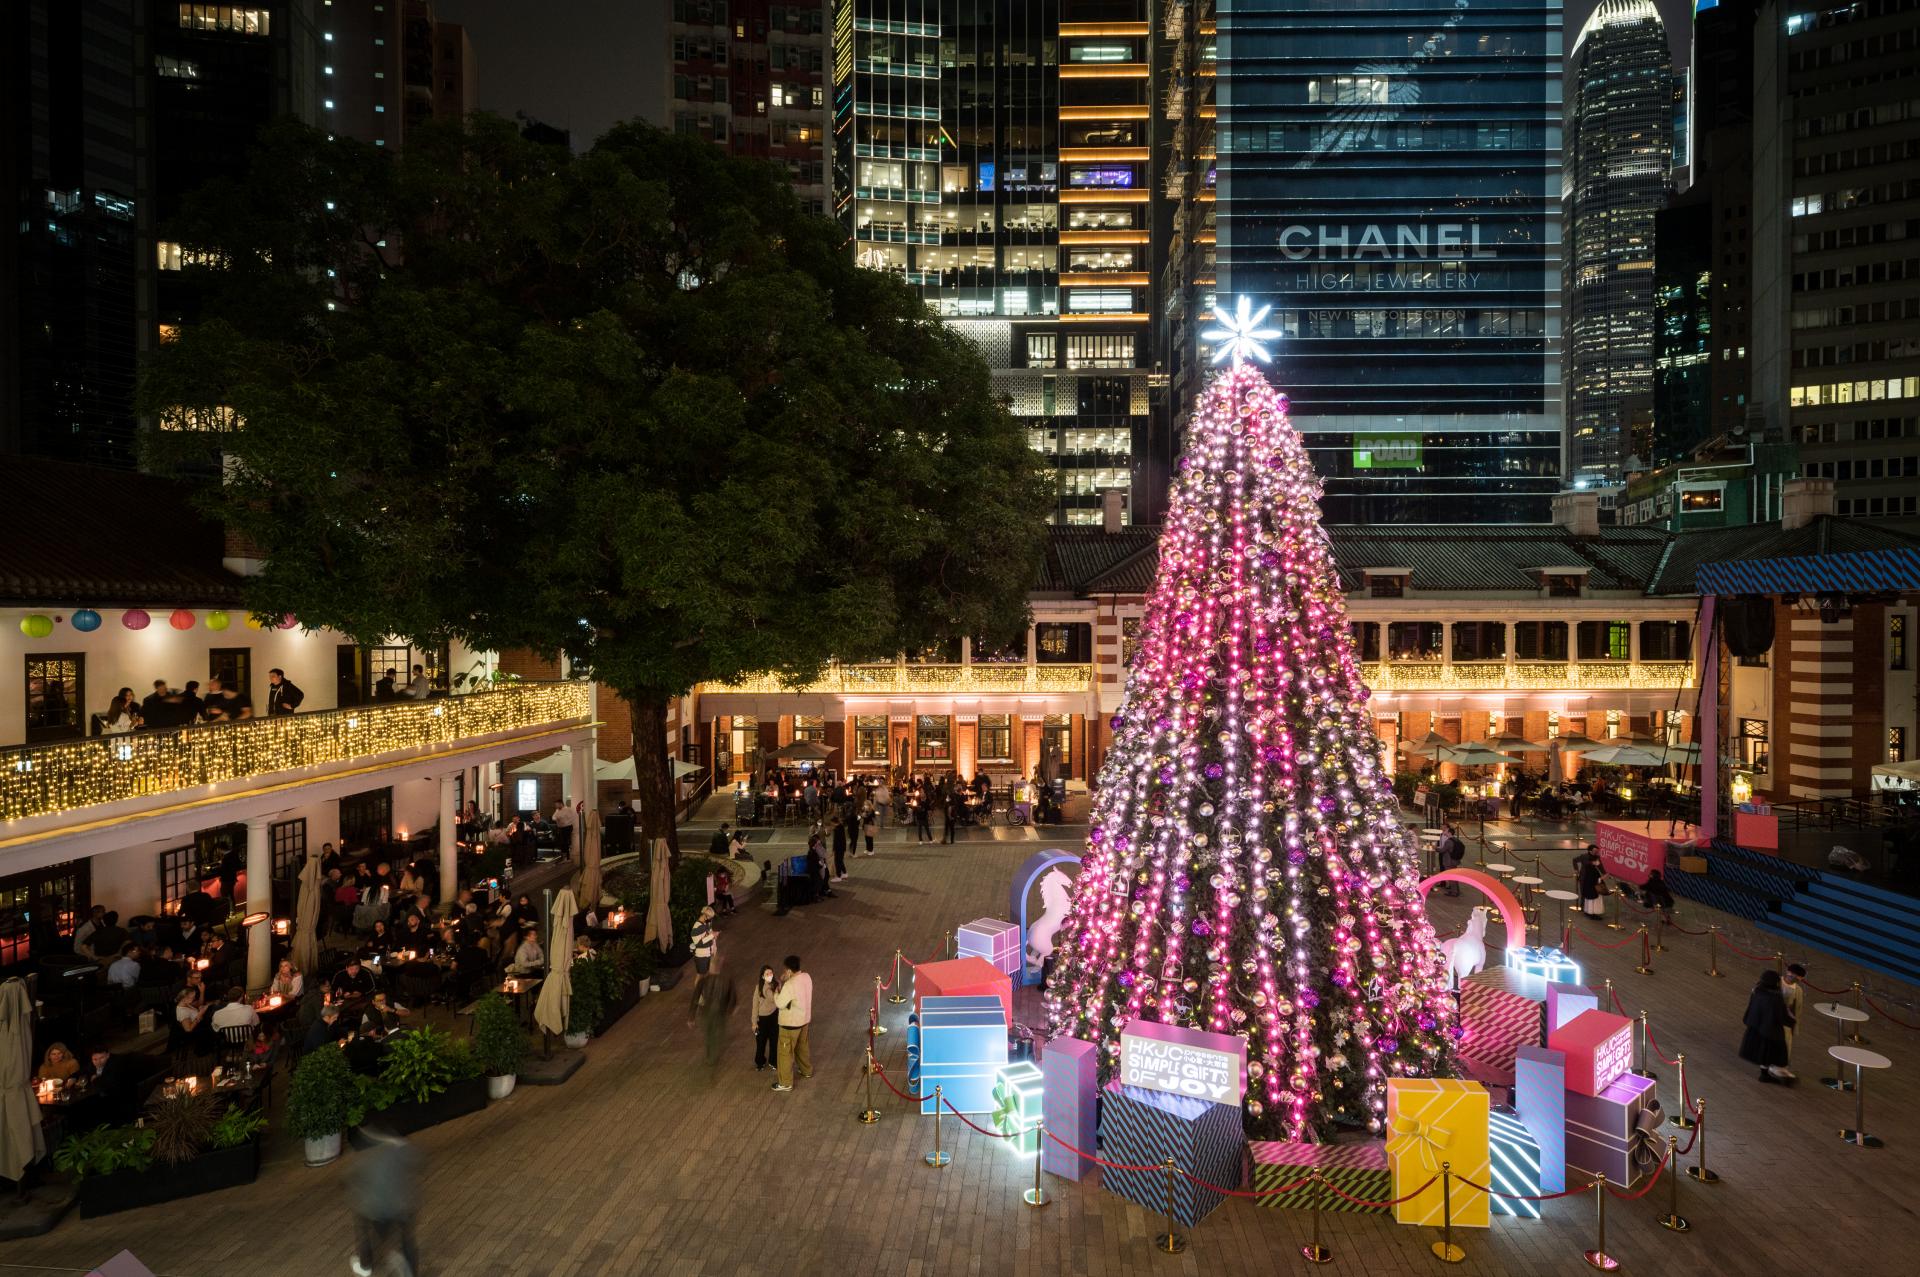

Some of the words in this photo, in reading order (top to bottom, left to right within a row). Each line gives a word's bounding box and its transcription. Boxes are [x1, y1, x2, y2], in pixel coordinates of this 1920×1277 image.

[1279, 224, 1497, 260] CHANEL
[1296, 273, 1354, 289] HIGH
[1363, 272, 1481, 291] JEWELLERY
[1308, 310, 1342, 321] NEW
[1378, 309, 1466, 321] COLLECTION
[1359, 439, 1417, 461] POAD
[1600, 827, 1626, 844] HKJC
[1600, 848, 1613, 858] OF
[1613, 855, 1649, 872] JOY
[1128, 1039, 1183, 1061] HKJC
[1596, 1050, 1616, 1076] SIMPLE
[1615, 1039, 1631, 1061] GIFTS
[1597, 1036, 1616, 1062] HKJC
[1128, 1054, 1180, 1075] SIMPLE
[1181, 1063, 1229, 1084] GIFTS
[1596, 1070, 1608, 1090] OF
[1607, 1052, 1632, 1082] JOY
[1129, 1068, 1157, 1083] OF
[1158, 1075, 1231, 1099] JOY
